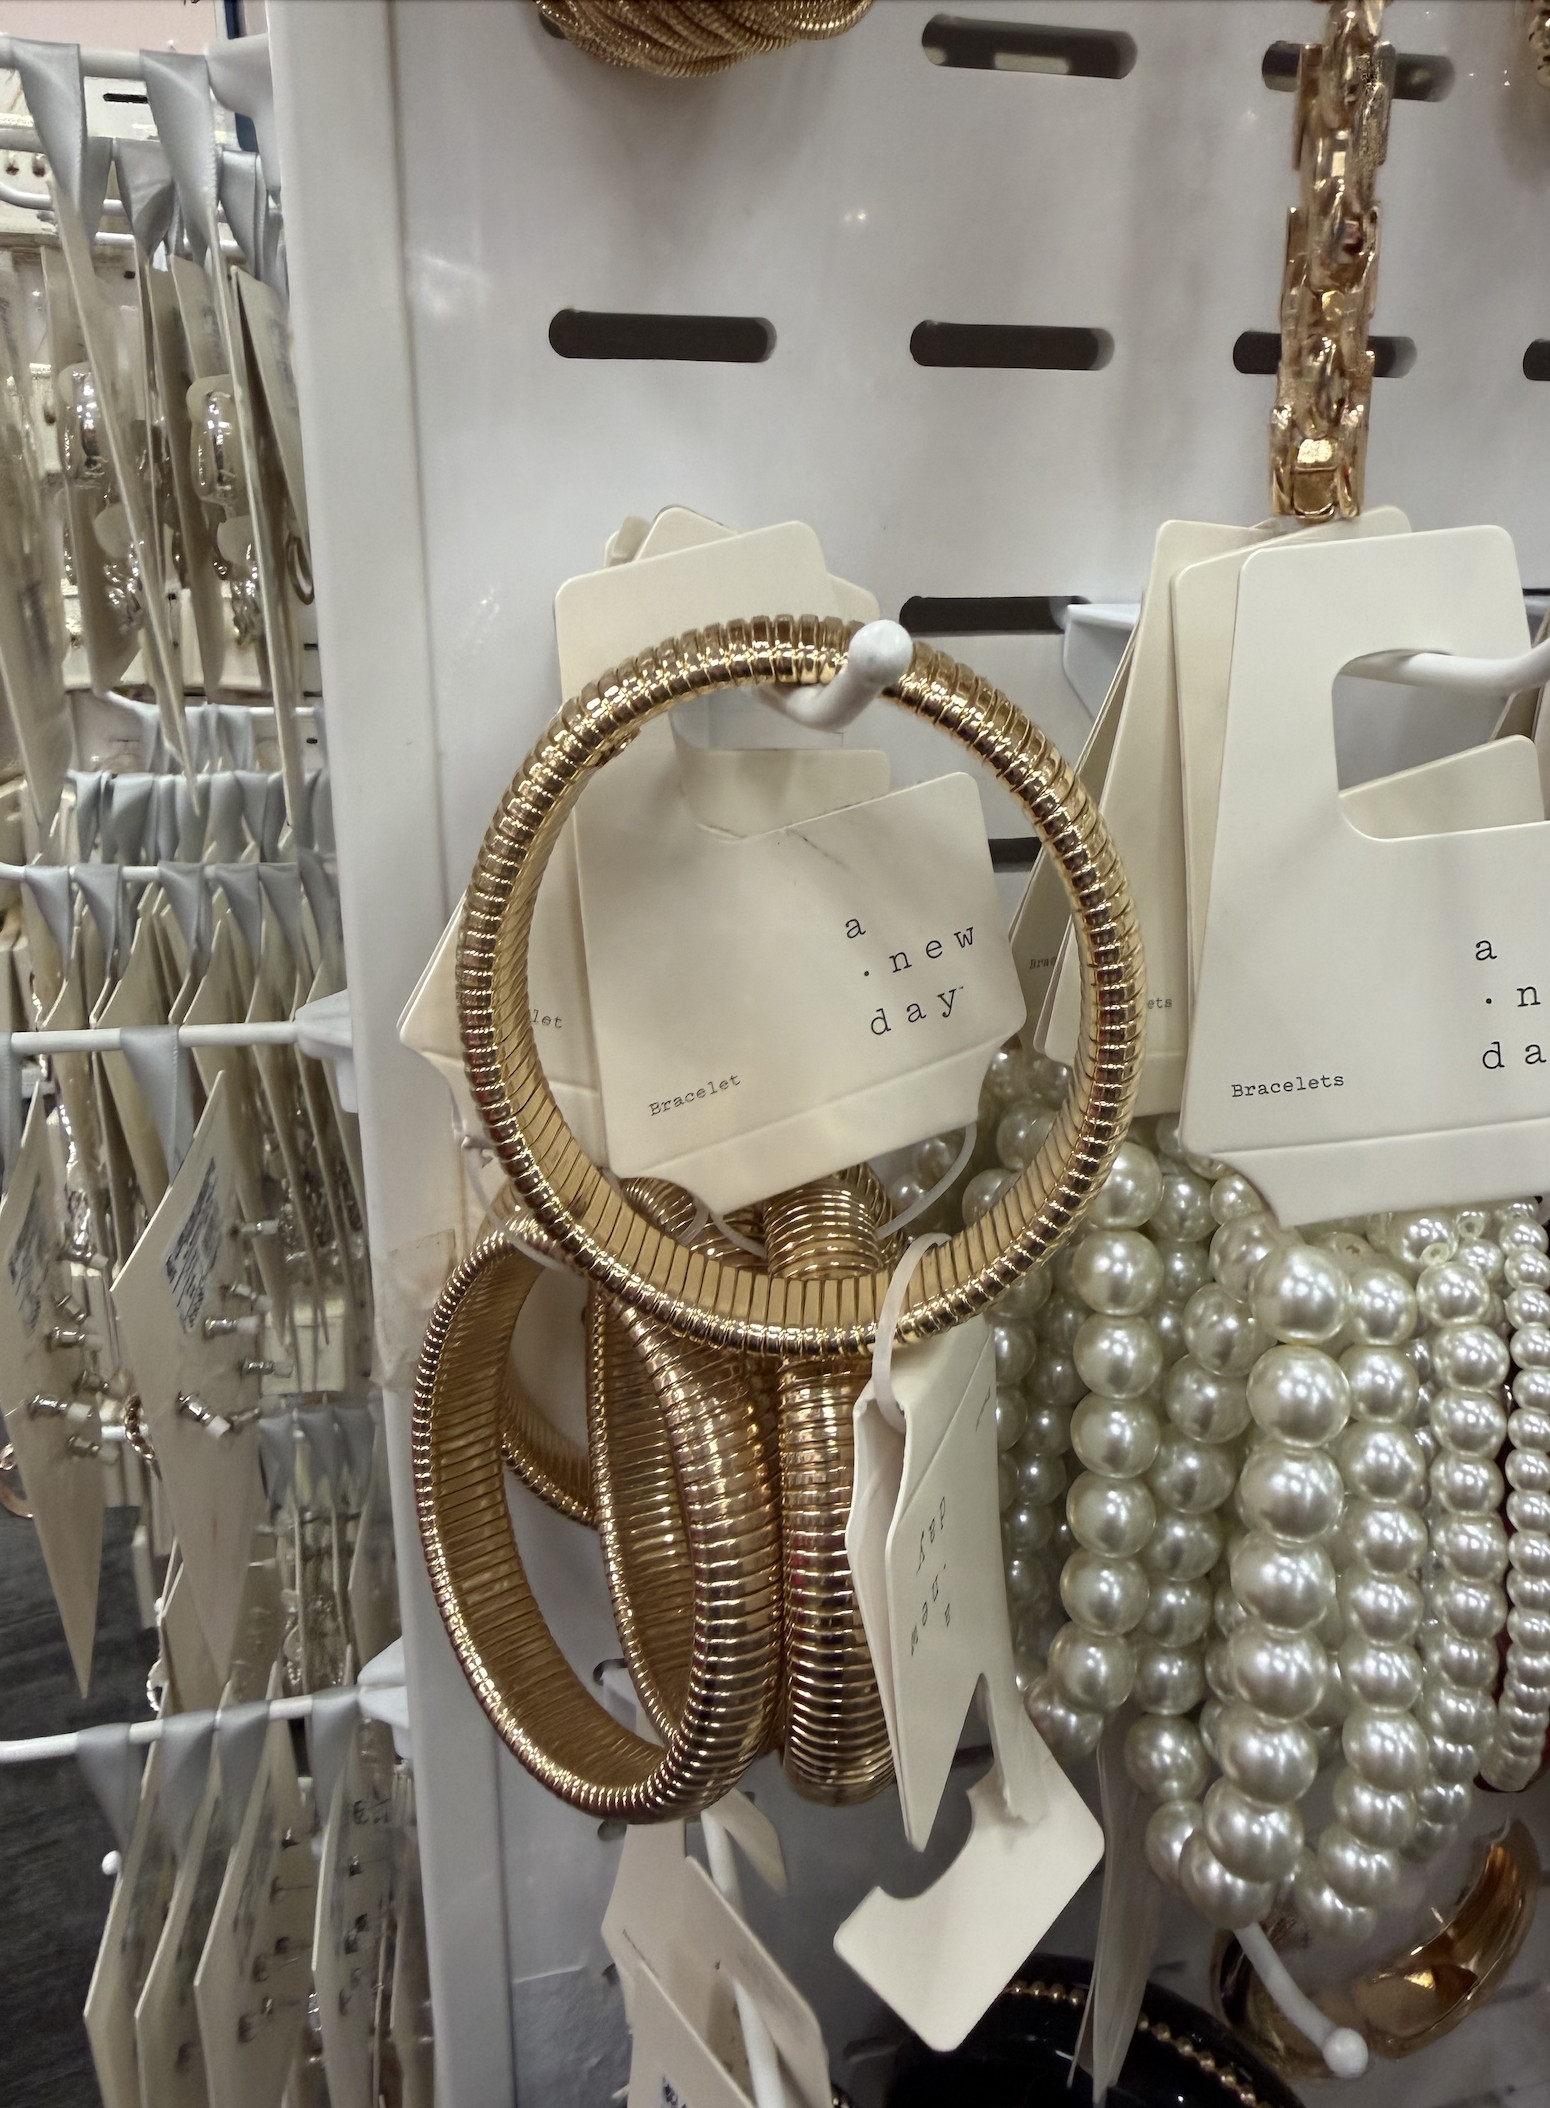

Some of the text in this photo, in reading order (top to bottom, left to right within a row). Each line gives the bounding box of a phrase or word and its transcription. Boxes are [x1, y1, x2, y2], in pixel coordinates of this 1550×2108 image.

[845, 918, 866, 939] a
[1475, 940, 1498, 961] a
[870, 986, 958, 1036] day
[1482, 1041, 1547, 1070] da
[648, 1074, 741, 1117] Bracelet
[1231, 1074, 1345, 1098] Bracelets
